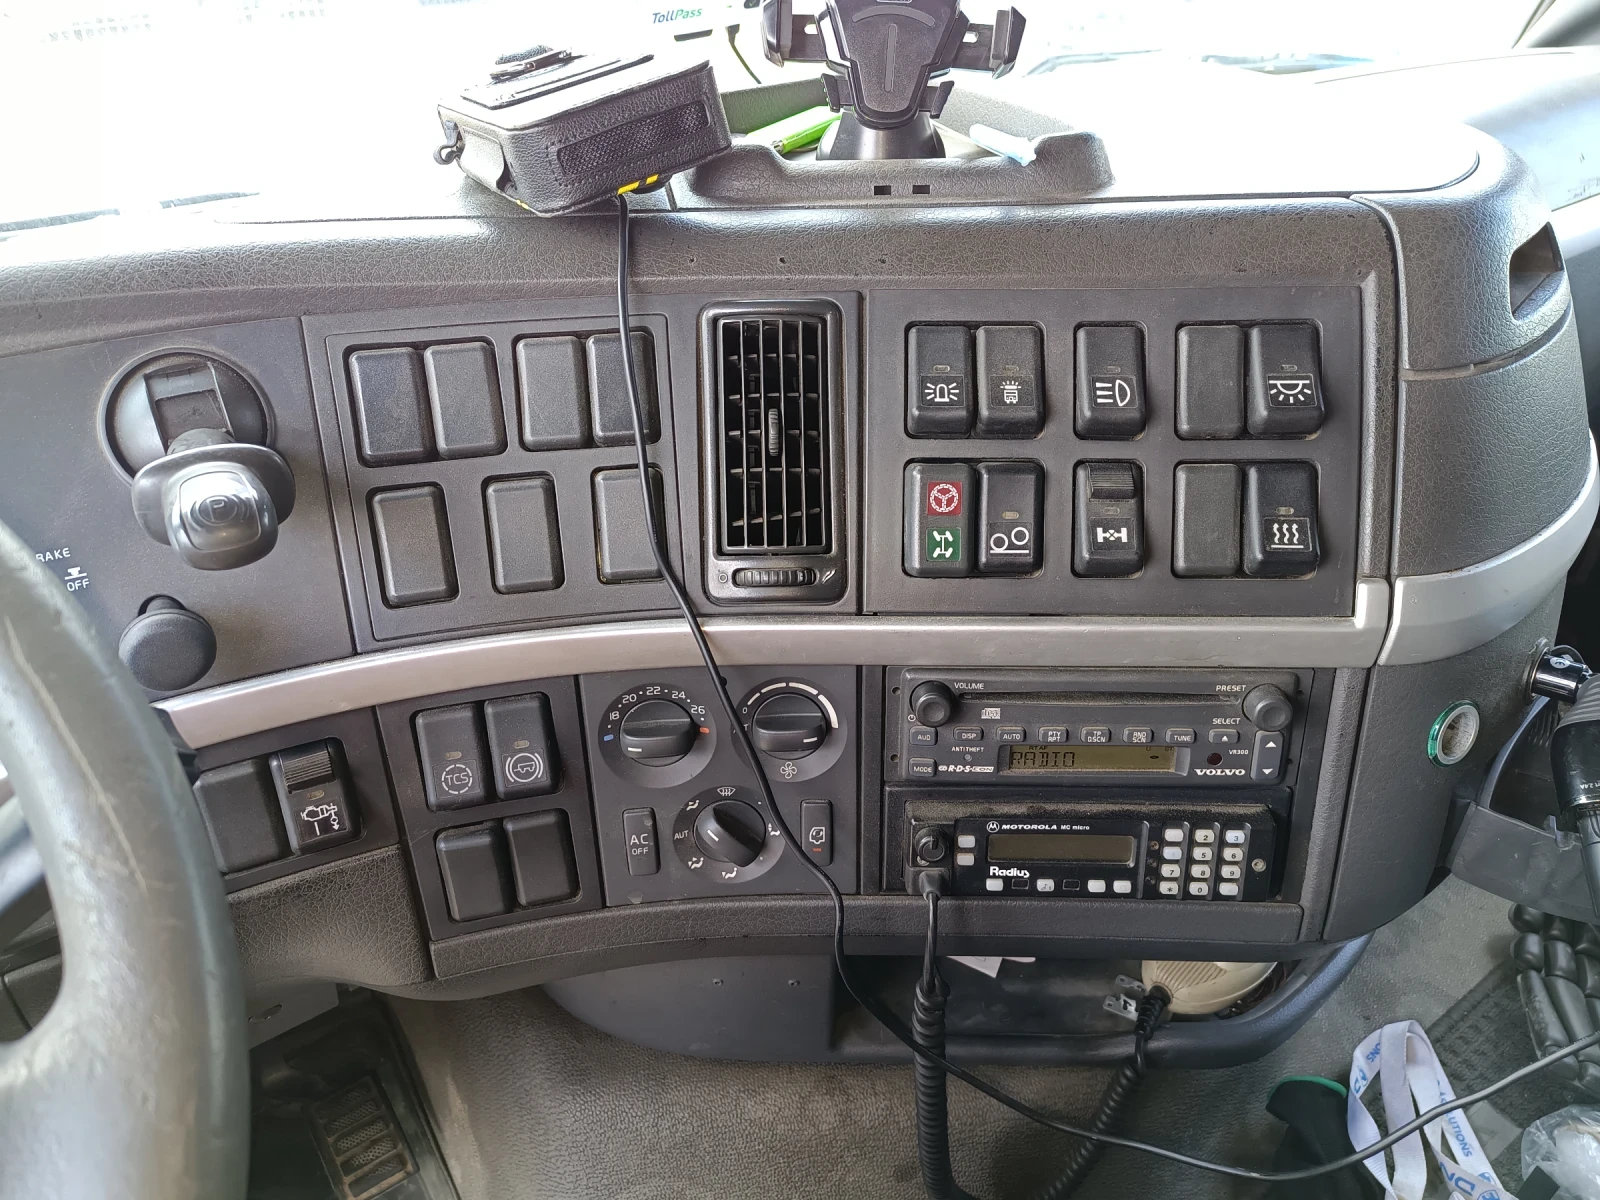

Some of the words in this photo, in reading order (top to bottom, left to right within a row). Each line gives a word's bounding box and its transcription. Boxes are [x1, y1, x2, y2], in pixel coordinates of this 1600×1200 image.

[652, 8, 703, 24] TollPass
[66, 578, 90, 591] OFF
[953, 682, 985, 690] VOLUME
[1215, 684, 1247, 692] PRESET
[609, 710, 620, 721] 18
[622, 693, 637, 704] 20
[646, 686, 661, 695] 22
[671, 690, 686, 699] 24
[690, 704, 706, 715] 26
[1212, 717, 1241, 725] SELECT
[1010, 751, 1076, 768] RADIO
[1193, 768, 1246, 776] VOLVO
[445, 772, 469, 786] TCS
[673, 829, 689, 840] AUT
[631, 846, 649, 856] OFF
[1231, 852, 1237, 860] 6
[989, 866, 1030, 878] Radius
